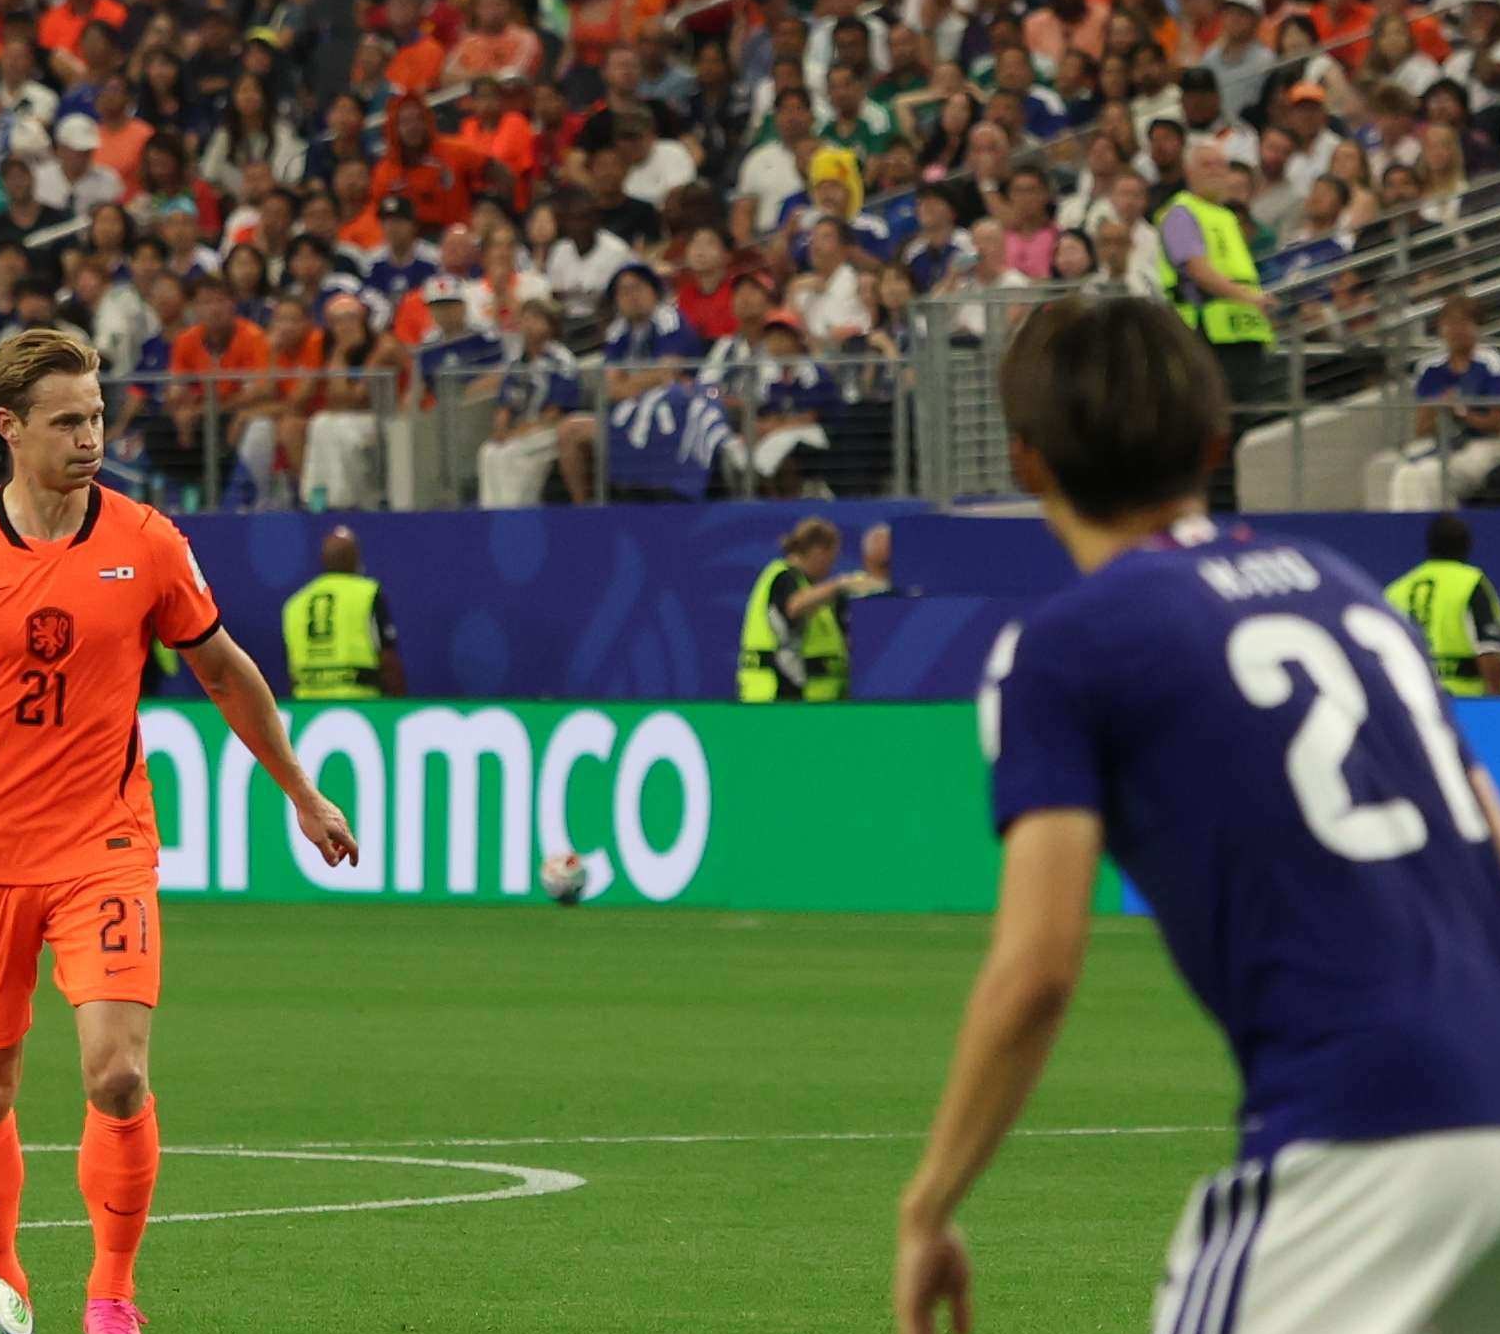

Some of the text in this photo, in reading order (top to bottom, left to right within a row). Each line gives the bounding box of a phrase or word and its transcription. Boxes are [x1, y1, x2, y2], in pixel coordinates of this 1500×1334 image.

[15, 669, 67, 726] 21
[1227, 603, 1492, 863] 21
[99, 896, 147, 955] 21
